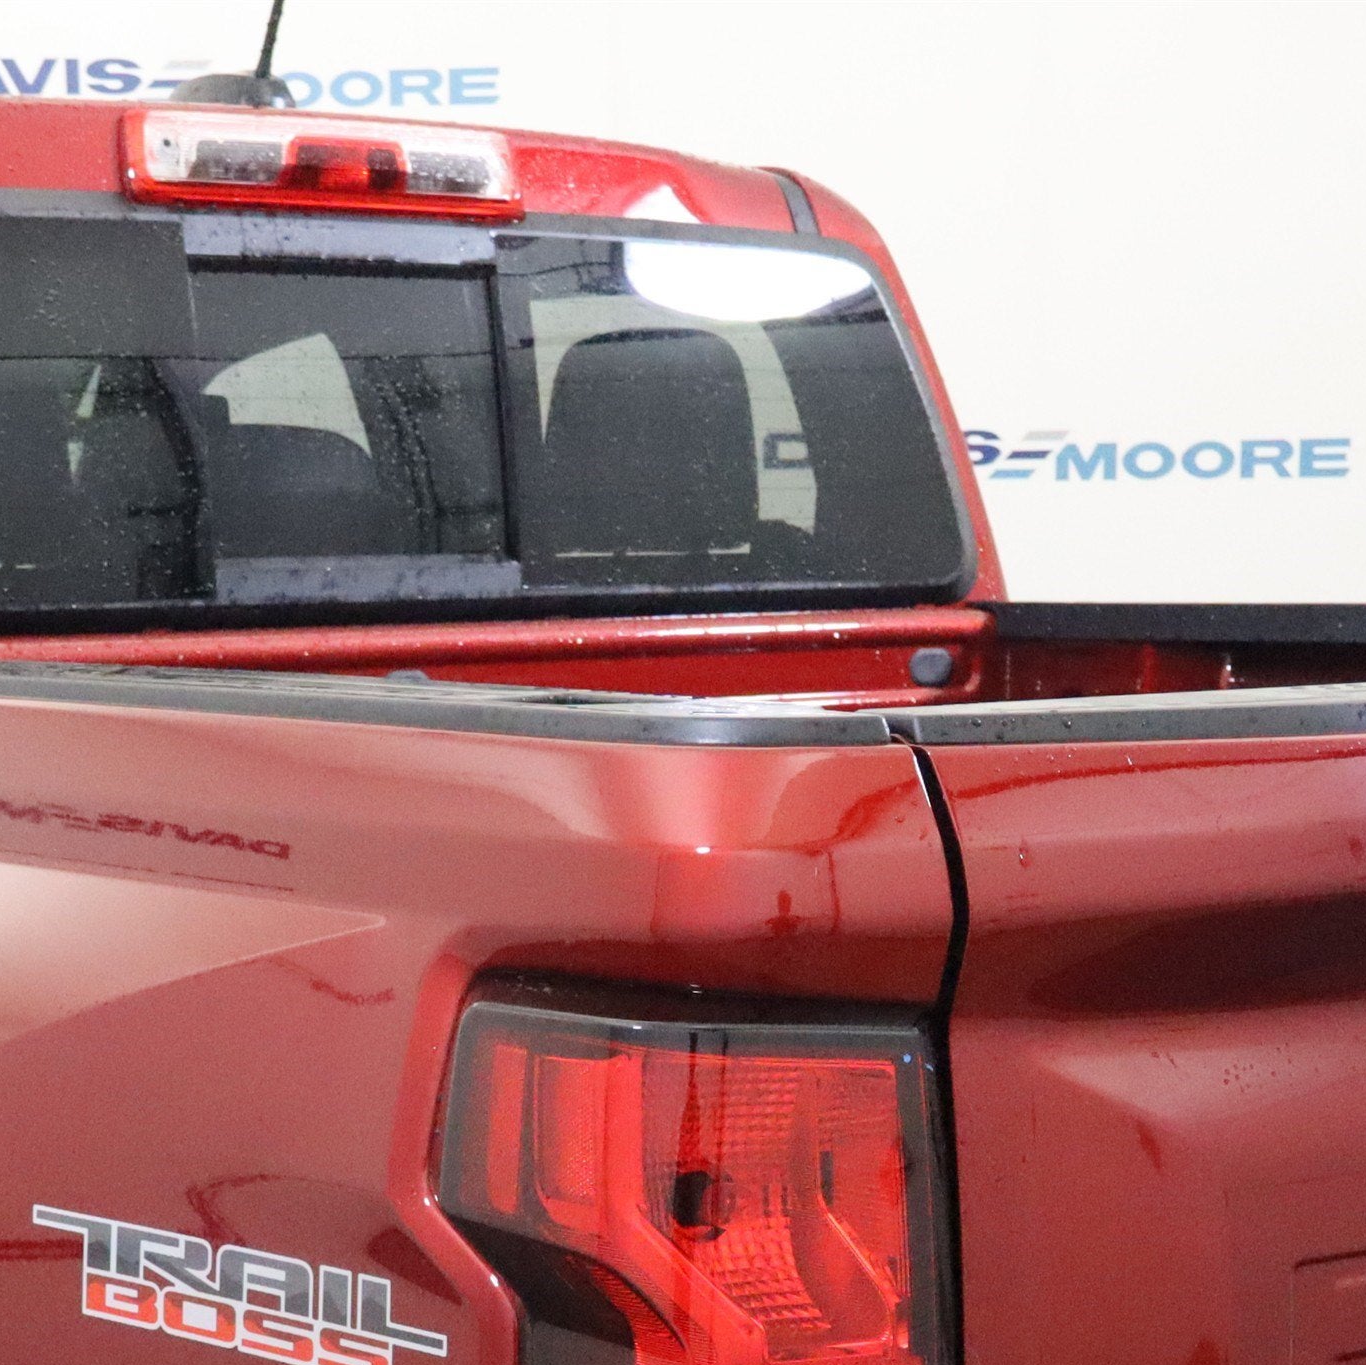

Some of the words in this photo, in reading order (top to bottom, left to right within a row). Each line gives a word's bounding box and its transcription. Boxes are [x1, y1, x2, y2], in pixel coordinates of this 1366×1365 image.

[281, 67, 500, 108] OORE
[1054, 437, 1352, 481] MOORE
[32, 1203, 448, 1358] TRAIL
